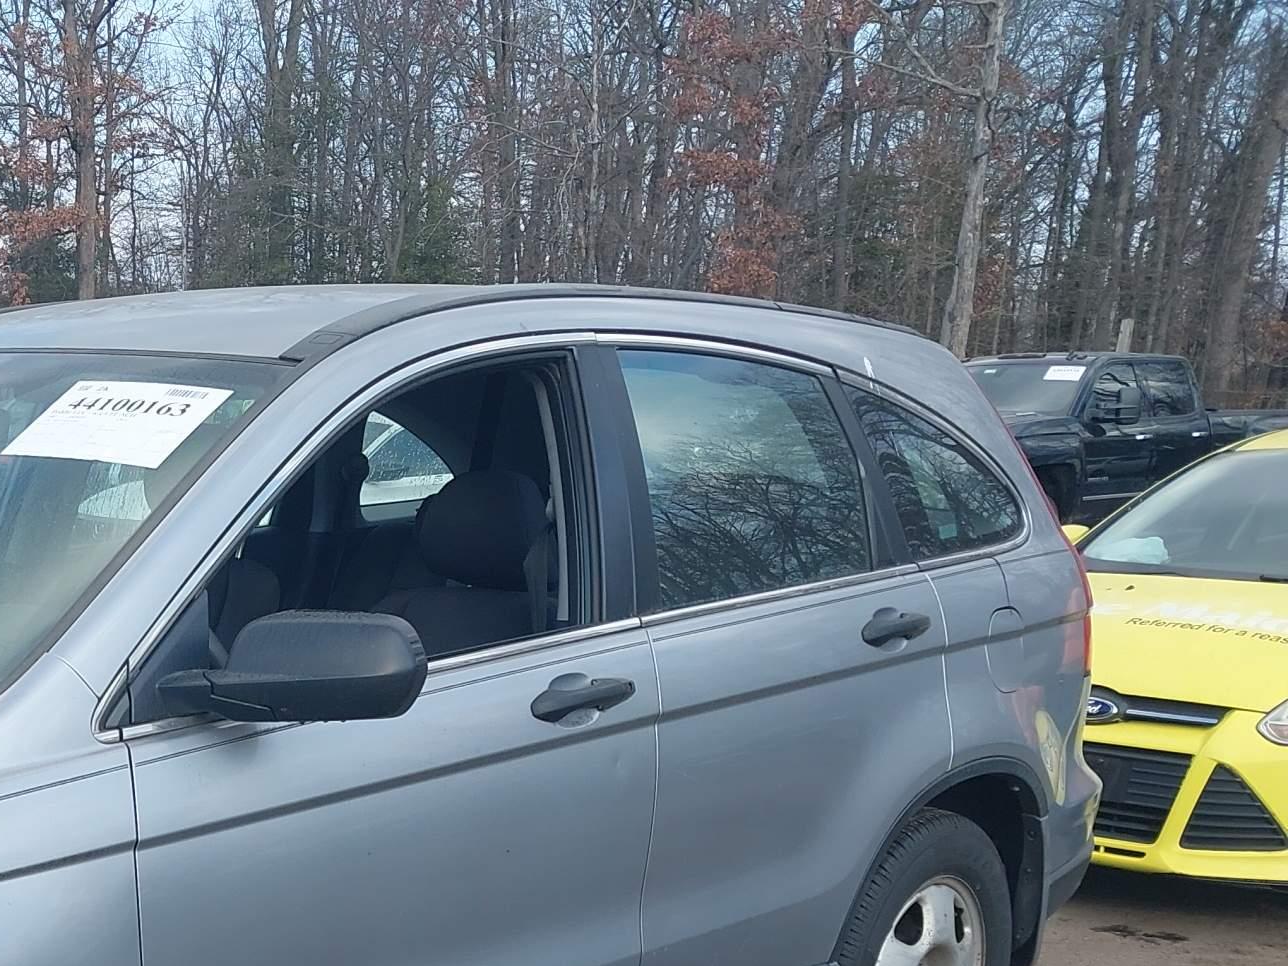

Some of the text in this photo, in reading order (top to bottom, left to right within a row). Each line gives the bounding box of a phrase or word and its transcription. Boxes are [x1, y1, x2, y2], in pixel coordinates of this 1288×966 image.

[68, 396, 192, 417] 44100163
[1125, 616, 1206, 631] Referred
[1205, 624, 1234, 635] for
